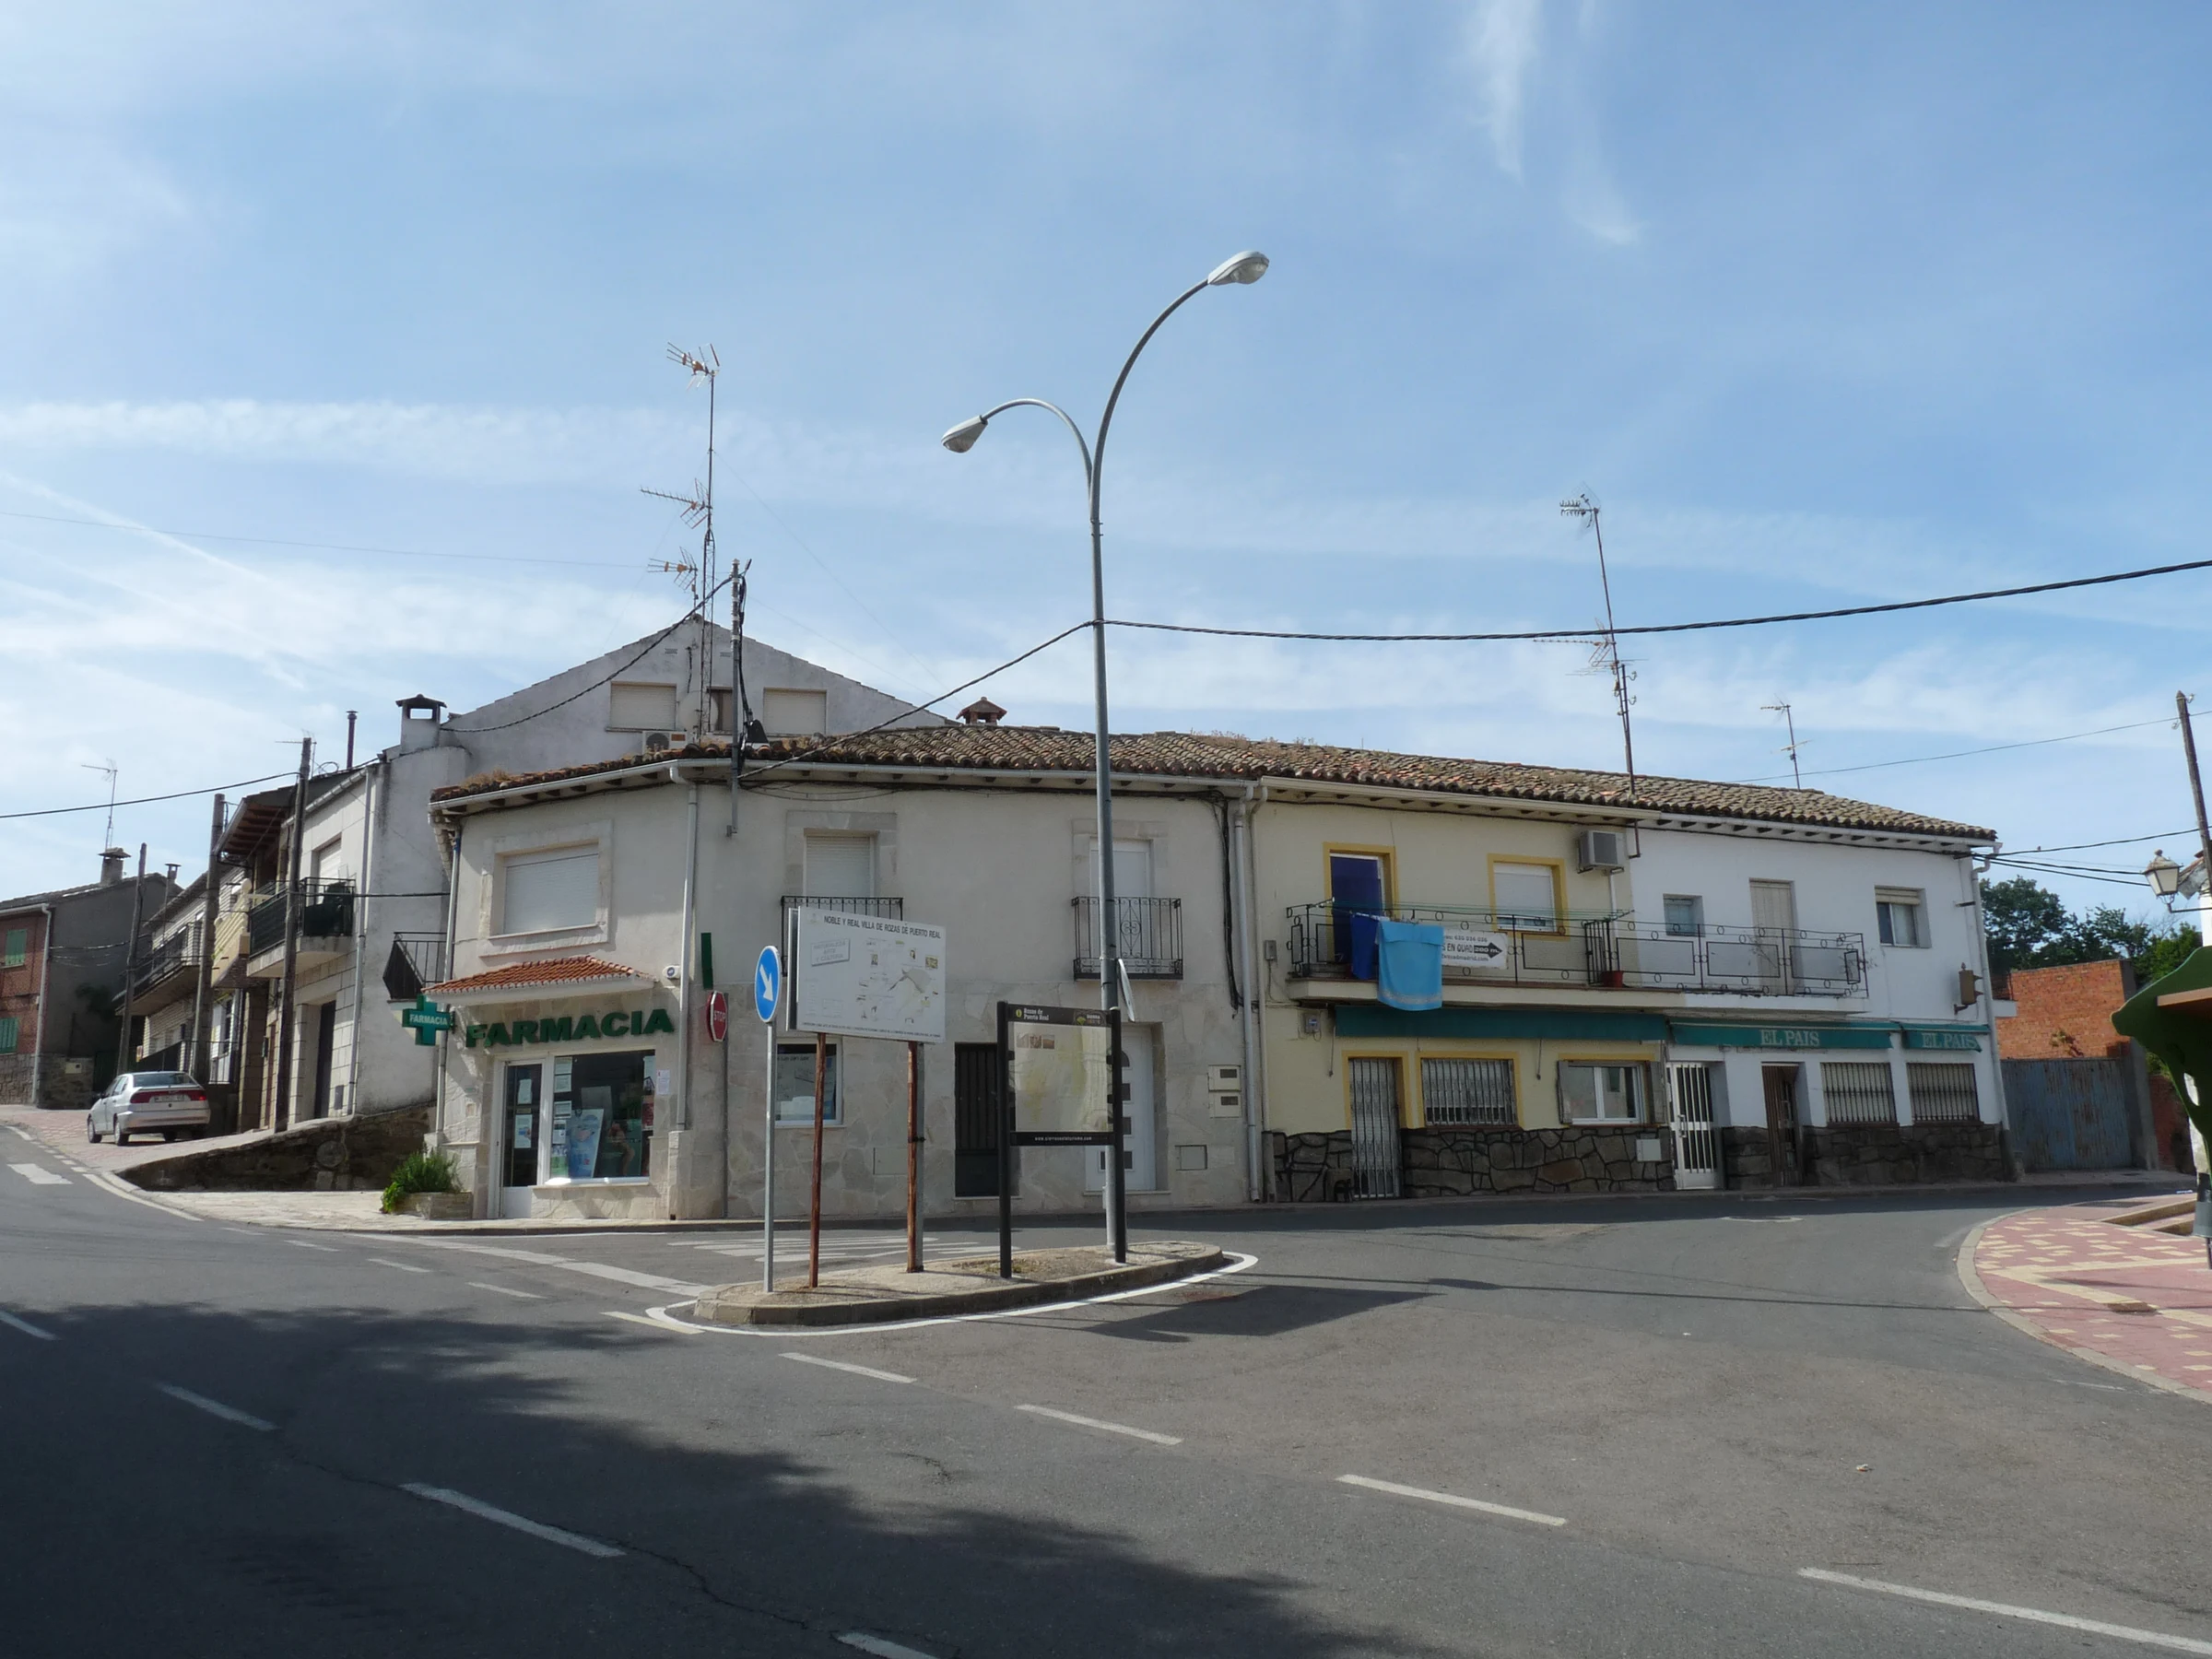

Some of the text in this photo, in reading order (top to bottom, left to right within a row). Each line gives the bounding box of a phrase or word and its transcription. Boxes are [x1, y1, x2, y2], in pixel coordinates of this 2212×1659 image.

[824, 916, 841, 925] NOBLE
[847, 919, 860, 928] REAL
[861, 921, 875, 929] VILLA
[877, 923, 883, 931] DE
[885, 924, 900, 933] ROZAS
[901, 926, 909, 935] DE
[910, 927, 927, 937] PUERTO
[929, 930, 941, 939] REAL
[1447, 943, 1455, 951] EN
[409, 1014, 448, 1025] FARMACIA
[714, 1010, 726, 1022] STOP
[465, 1008, 674, 1048] FARMACIA
[1759, 1029, 1783, 1045] EL
[1922, 1032, 1942, 1048] EL
